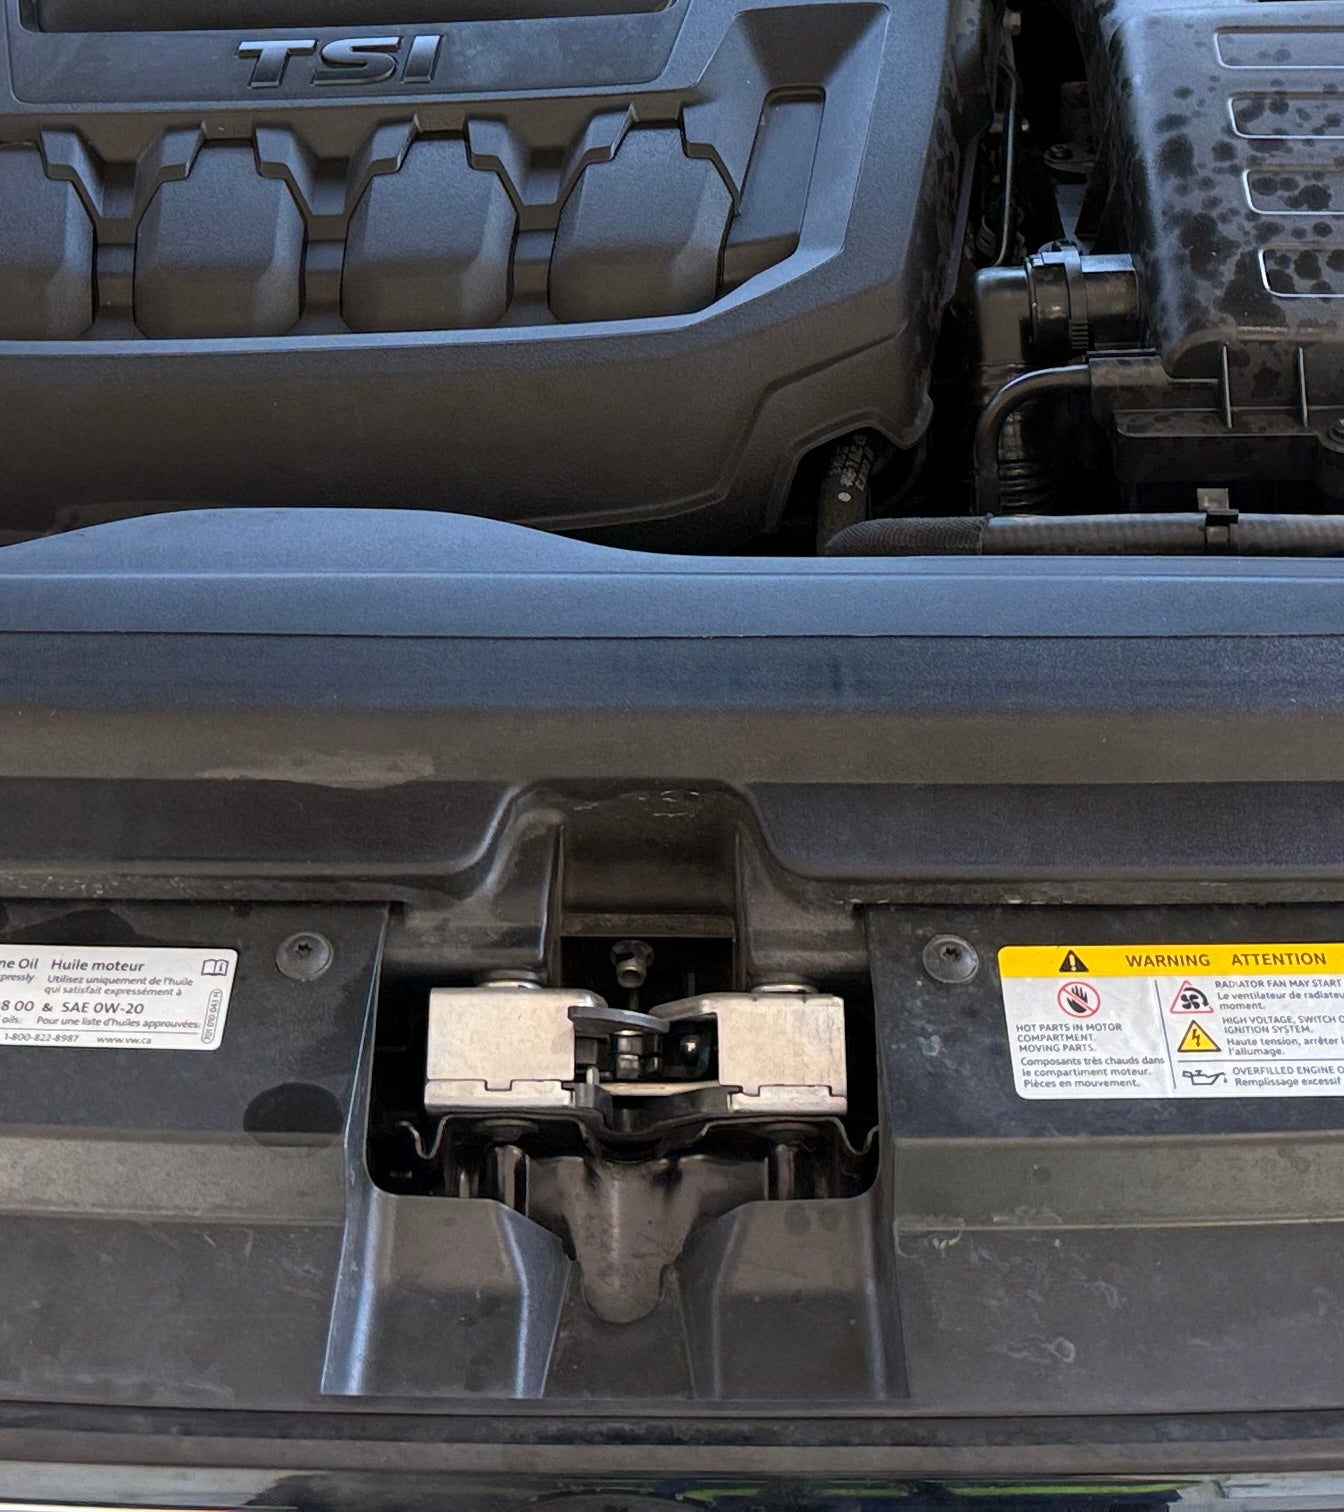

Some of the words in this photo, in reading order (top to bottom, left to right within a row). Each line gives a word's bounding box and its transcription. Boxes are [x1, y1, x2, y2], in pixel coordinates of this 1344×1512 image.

[235, 35, 443, 88] TSI
[18, 958, 39, 969] Oil
[50, 959, 89, 971] Huile
[91, 960, 145, 972] moteur
[1125, 954, 1211, 968] WARNING
[1231, 952, 1327, 966] ATTENTION
[85, 975, 147, 986] uniquement
[148, 976, 162, 986] de
[163, 977, 194, 986] l'huile
[1214, 979, 1265, 989] RADIATOR
[1266, 980, 1287, 988] FAN
[1288, 979, 1310, 988] MAY
[1311, 979, 1342, 988] START
[44, 985, 62, 995] qui
[62, 985, 102, 995] satisfait
[103, 987, 174, 997] expressément
[175, 988, 182, 997] à
[1216, 992, 1230, 1000] Le
[1231, 990, 1287, 1000] ventilateur
[1288, 990, 1302, 1000] de
[14, 1000, 35, 1012] 00
[41, 1002, 54, 1012] &
[61, 1001, 90, 1014] SAE
[93, 1002, 144, 1015] 0W-20
[36, 1016, 60, 1025] Pour
[60, 1018, 81, 1026] une
[81, 1017, 102, 1026] liste
[102, 1017, 141, 1027] d'huiles
[1221, 1016, 1248, 1025] HIGH
[1297, 1015, 1337, 1024] SWITCH
[1016, 1024, 1037, 1033] HOT
[1038, 1023, 1071, 1032] PARTS
[1072, 1023, 1084, 1032] IN
[1085, 1022, 1123, 1032] MOTOR
[1224, 1025, 1270, 1035] IGNITION
[4, 1032, 80, 1043] 1-800-822-8987
[1226, 1037, 1258, 1046] Haute
[1259, 1037, 1302, 1047] tension,
[1303, 1036, 1339, 1046] arrêter
[1018, 1044, 1061, 1053] MOVING
[1020, 1057, 1082, 1067] Composants
[1083, 1056, 1103, 1066] très
[1104, 1056, 1140, 1066] chauds
[1141, 1056, 1166, 1065] dans
[1022, 1068, 1032, 1077] le
[1034, 1068, 1108, 1078] compartiment
[1232, 1066, 1295, 1076] OVERFILLED
[1296, 1065, 1335, 1075] ENGINE
[1023, 1079, 1057, 1088] Pièces
[1057, 1078, 1072, 1088] en
[1074, 1078, 1140, 1088] mouvement.
[1234, 1077, 1299, 1088] Remplissage
[1301, 1076, 1341, 1086] excessif
